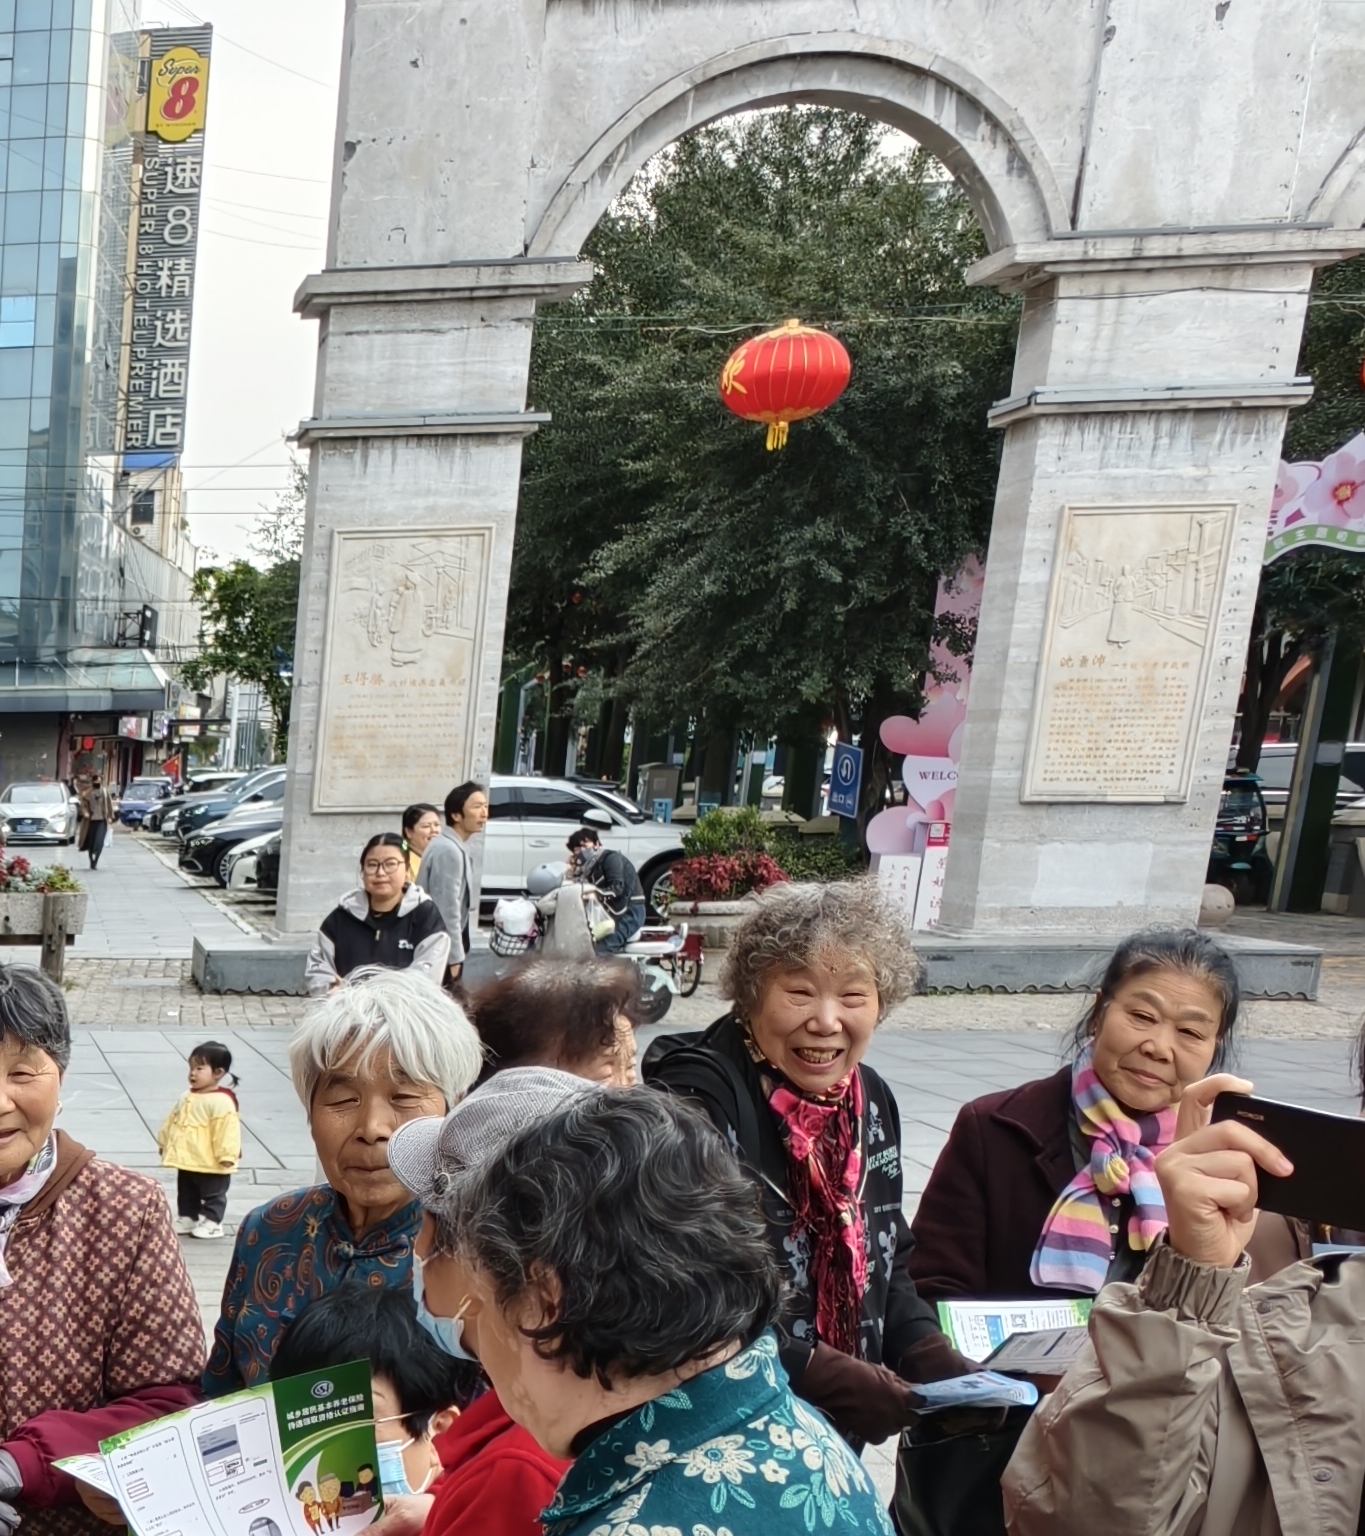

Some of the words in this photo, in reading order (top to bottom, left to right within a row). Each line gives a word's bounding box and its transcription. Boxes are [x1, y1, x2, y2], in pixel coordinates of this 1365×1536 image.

[158, 58, 202, 84] Super
[161, 76, 200, 121] 8
[142, 157, 161, 233] SUPER
[138, 243, 153, 255] 8
[132, 260, 151, 343] HOTEL
[145, 155, 202, 449] 速8精选酒店
[126, 345, 148, 448] PREMIER
[918, 771, 960, 781] WELC
